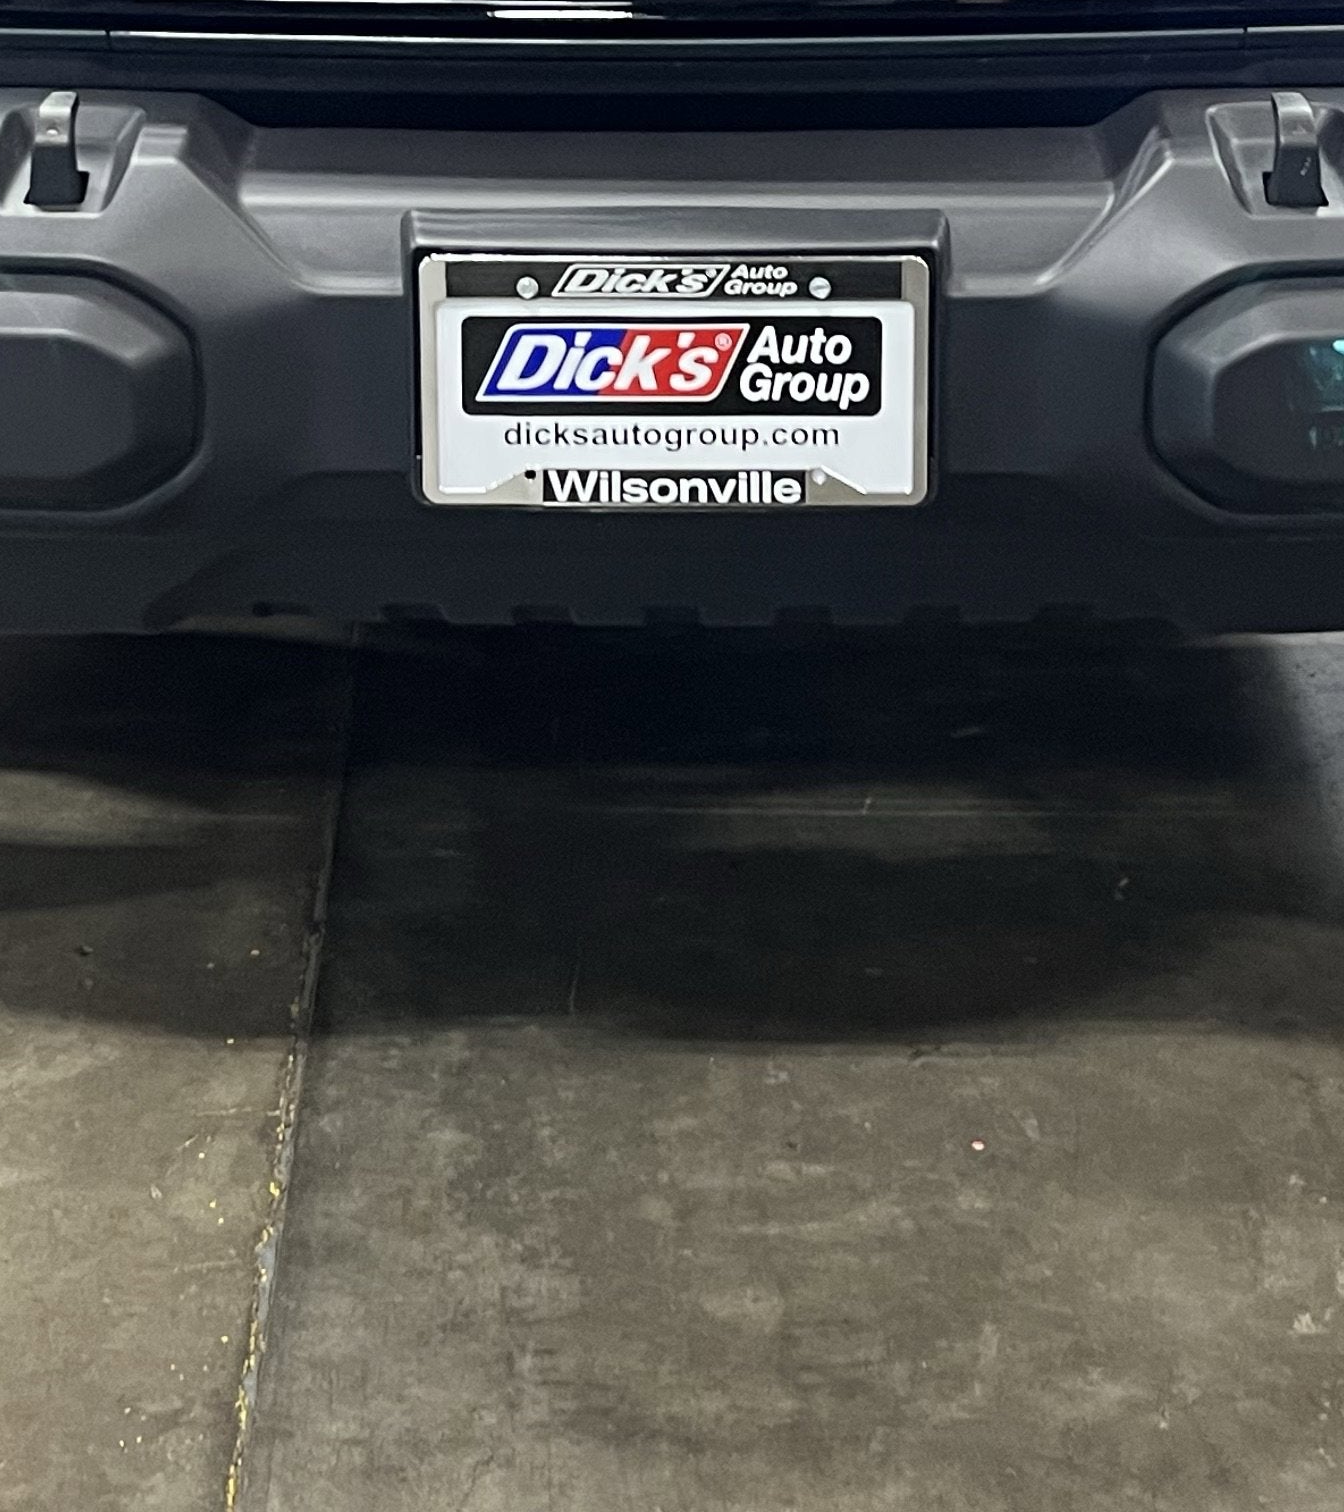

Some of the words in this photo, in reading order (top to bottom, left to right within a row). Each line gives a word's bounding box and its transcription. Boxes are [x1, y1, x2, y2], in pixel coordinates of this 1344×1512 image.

[564, 267, 709, 294] Dick's
[730, 264, 789, 280] Auto
[724, 279, 798, 298] Group
[496, 331, 719, 391] Dick's
[747, 325, 853, 365] Auto
[739, 363, 870, 410] Group
[504, 423, 840, 452] dicksautogroup.com
[547, 469, 802, 504] Wilsonville
